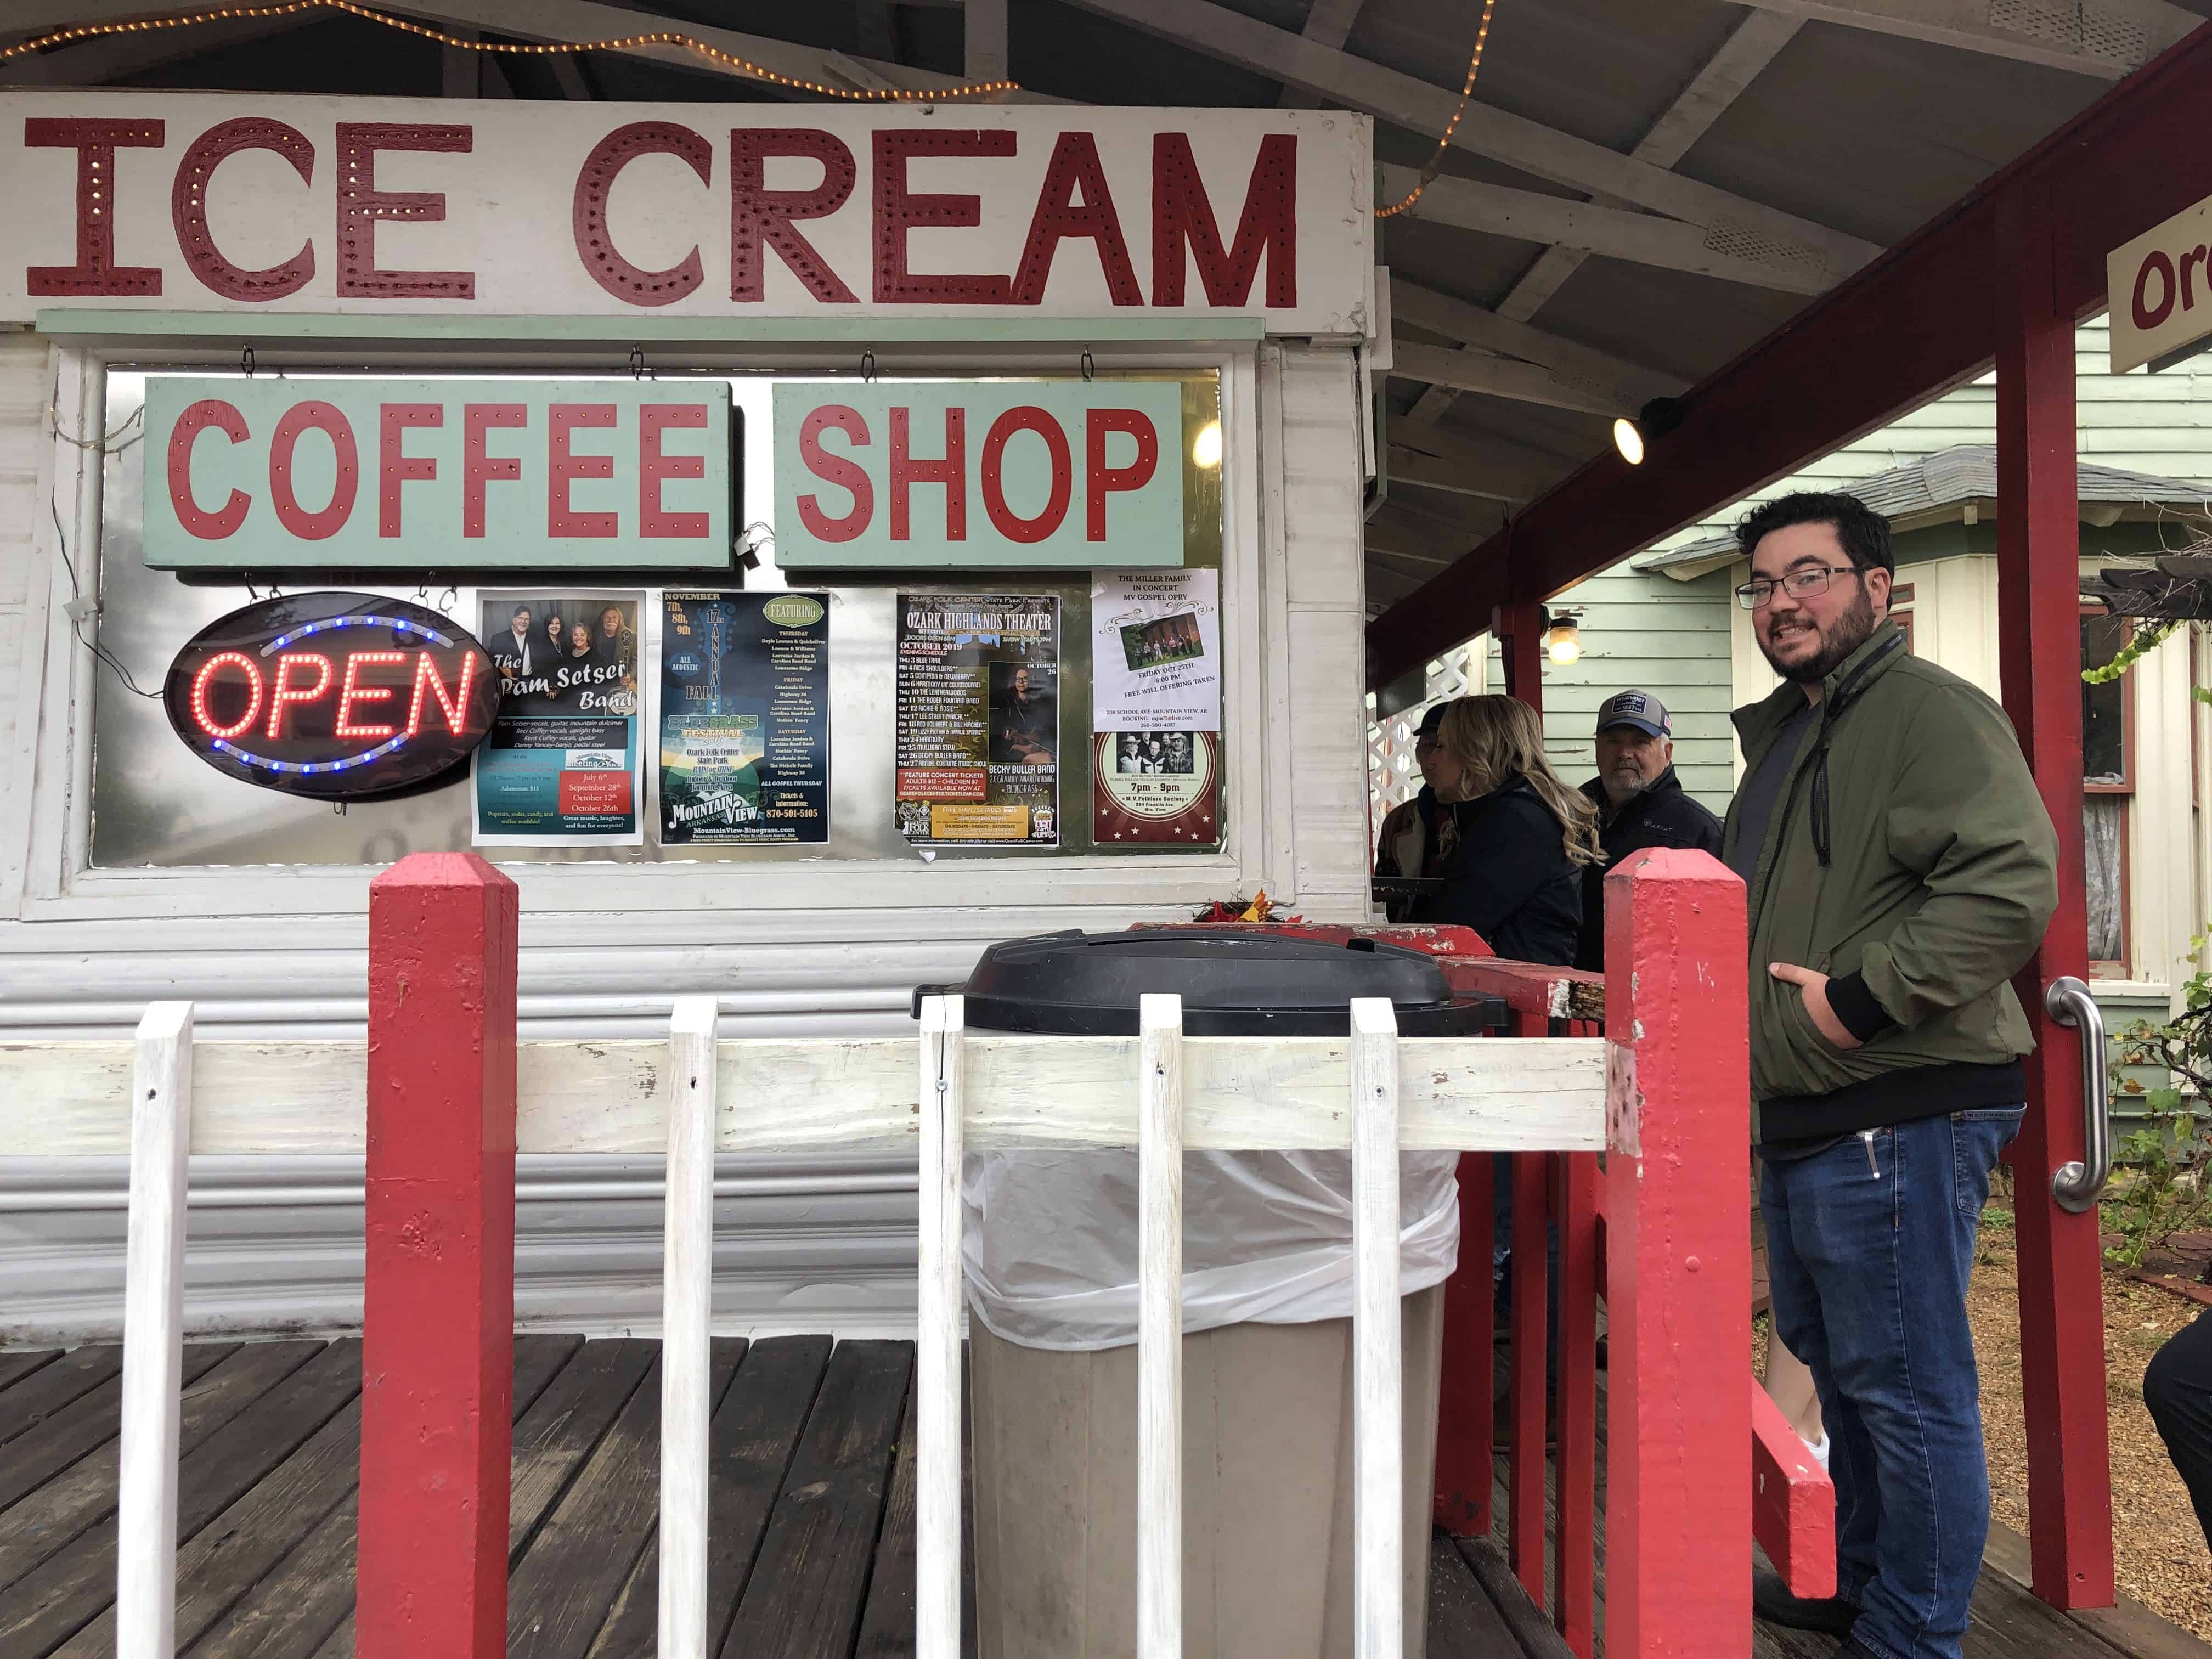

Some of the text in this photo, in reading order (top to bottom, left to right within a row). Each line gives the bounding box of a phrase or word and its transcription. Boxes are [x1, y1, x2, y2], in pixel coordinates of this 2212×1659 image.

[25, 117, 1297, 308] ICE CREAM
[2132, 244, 2212, 330] Or
[167, 399, 1158, 543] COFFEE SHOP
[667, 602, 682, 612] 7th,
[771, 605, 816, 618] FEATURING
[672, 613, 688, 624] 8th,
[907, 612, 1051, 630] OZARK HIGHLANDS THEATER
[677, 625, 690, 635] 9th
[494, 654, 521, 668] The
[1138, 669, 1161, 678] FRIDAY
[1178, 663, 1194, 671] 25TH
[501, 663, 625, 696] Pam Setser
[1124, 675, 1215, 698] FREE WILL OFFERING TAKEN
[193, 651, 474, 737] OPEN
[579, 691, 633, 709] Band
[686, 686, 719, 700] FALL
[669, 715, 758, 729] BLUEGRASS
[682, 729, 745, 738] FESTIVAL
[989, 765, 1055, 774] BECKY BULLER BAND
[692, 784, 718, 792] Jamming
[1006, 785, 1037, 793] BLUEGRASS
[1131, 783, 1180, 793] 7pm 9pm
[669, 793, 734, 828] MOUNTAIN
[725, 800, 758, 824] VIEW
[766, 809, 818, 818] 870-501-5105
[686, 811, 725, 827] ARKANSAS
